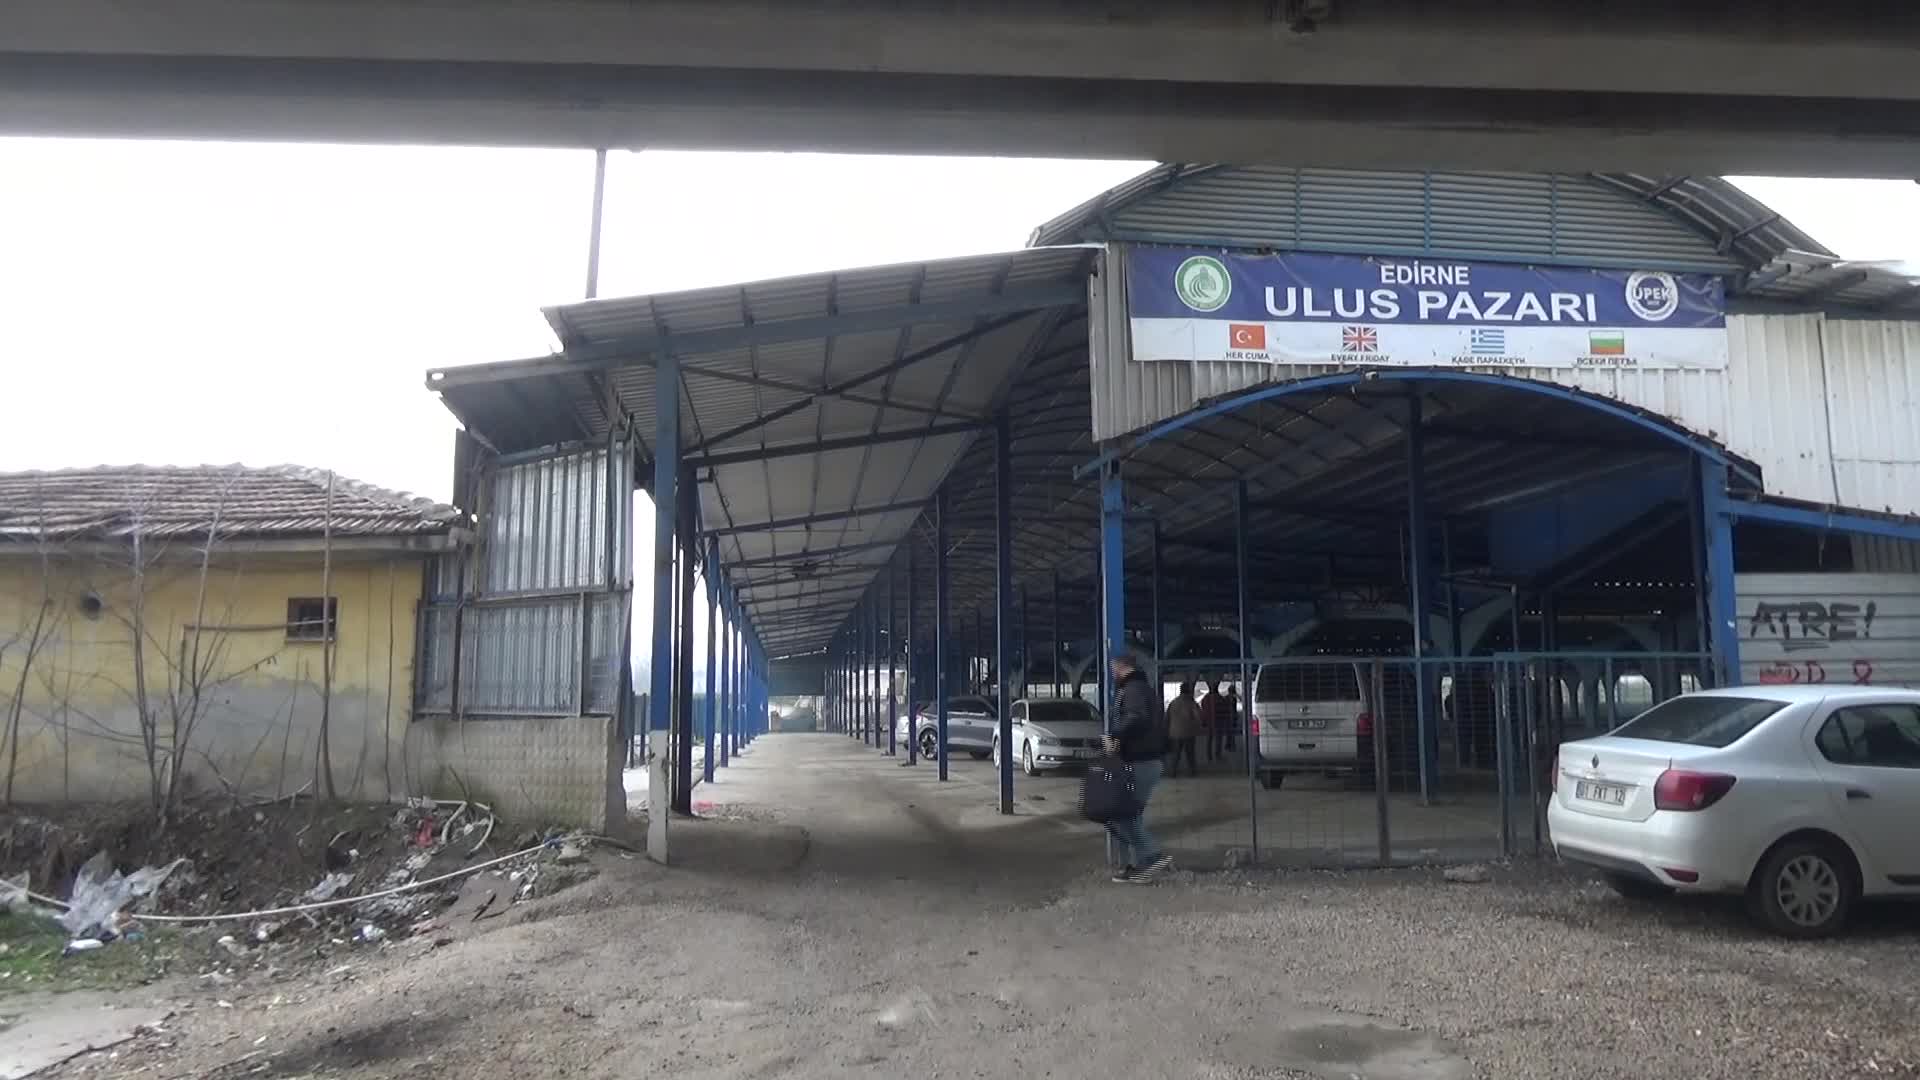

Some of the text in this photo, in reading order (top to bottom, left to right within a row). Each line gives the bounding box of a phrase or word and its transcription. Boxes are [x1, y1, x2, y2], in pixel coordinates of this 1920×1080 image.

[1380, 260, 1470, 285] EDİRNE
[1264, 286, 1400, 318] ULUS
[1418, 290, 1597, 322] PAZARI
[1225, 351, 1270, 361] HER CUMA
[1331, 354, 1390, 363] EVERY FRIDAY
